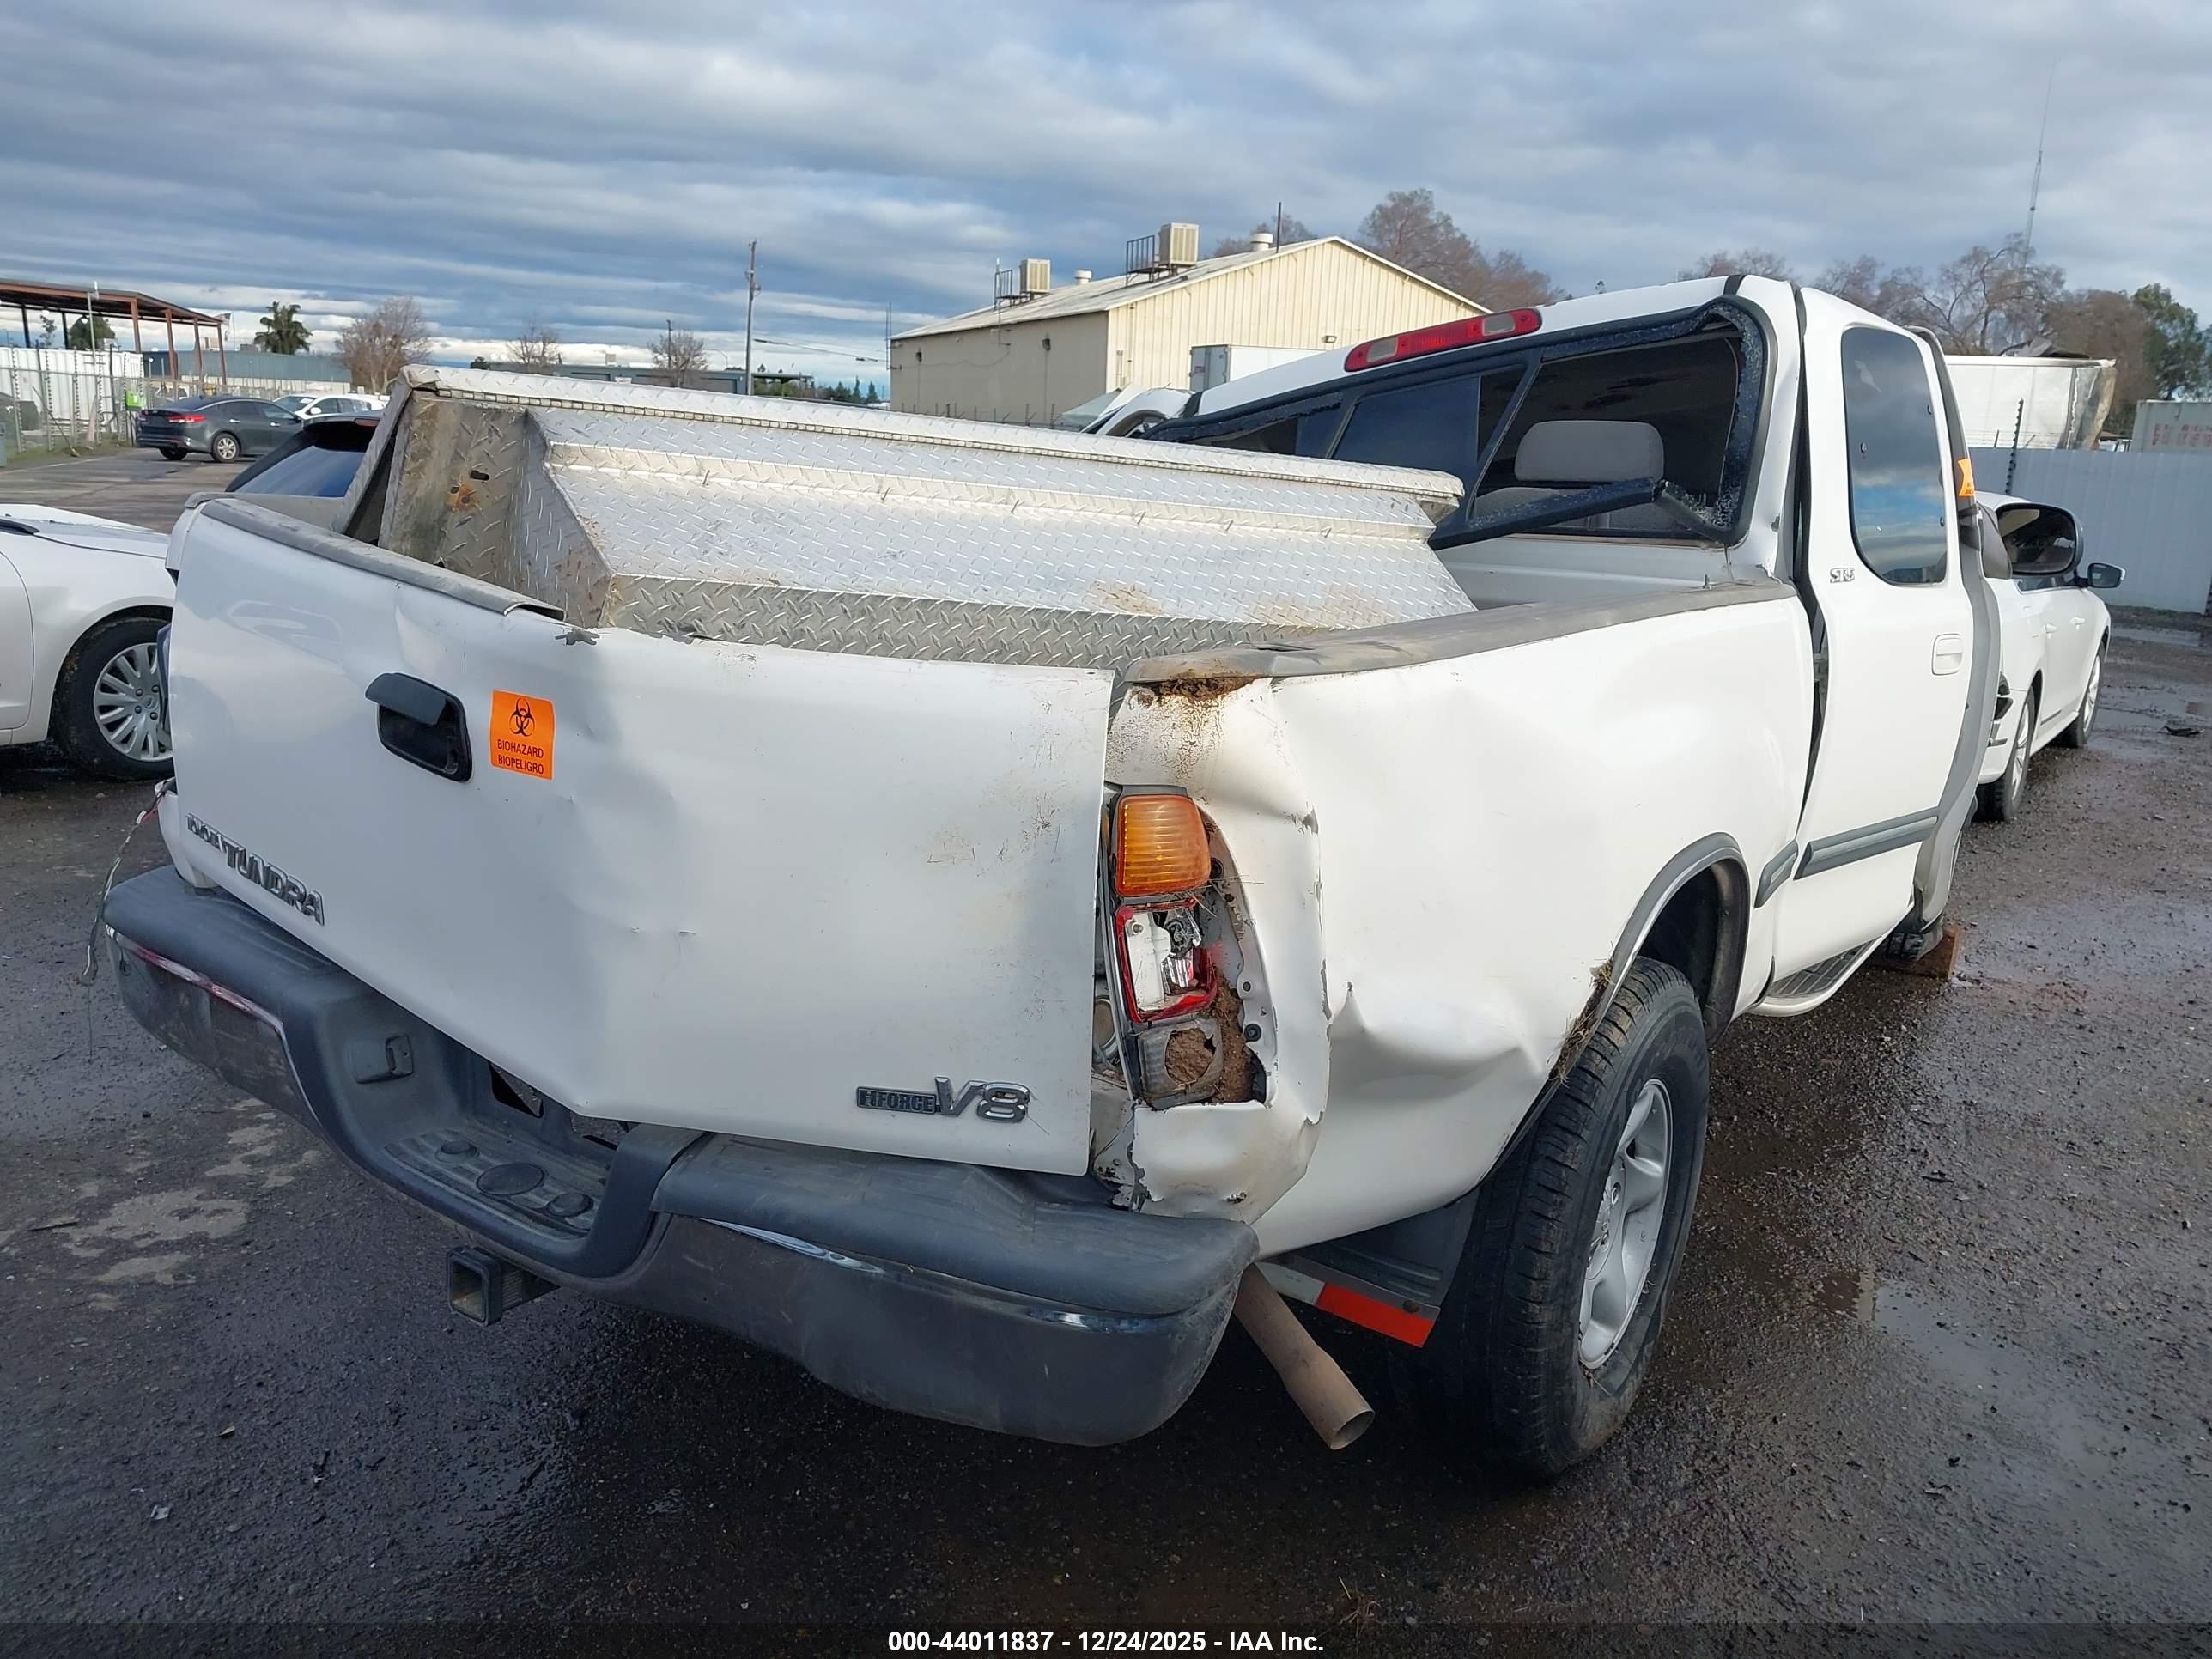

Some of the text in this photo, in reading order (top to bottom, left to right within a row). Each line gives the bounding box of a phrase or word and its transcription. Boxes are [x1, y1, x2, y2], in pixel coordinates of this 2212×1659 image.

[497, 738, 544, 758] BIOHAZARD
[498, 754, 544, 775] BIOPELIGRO
[222, 836, 325, 926] TUNDRA
[934, 1076, 1030, 1123] V8
